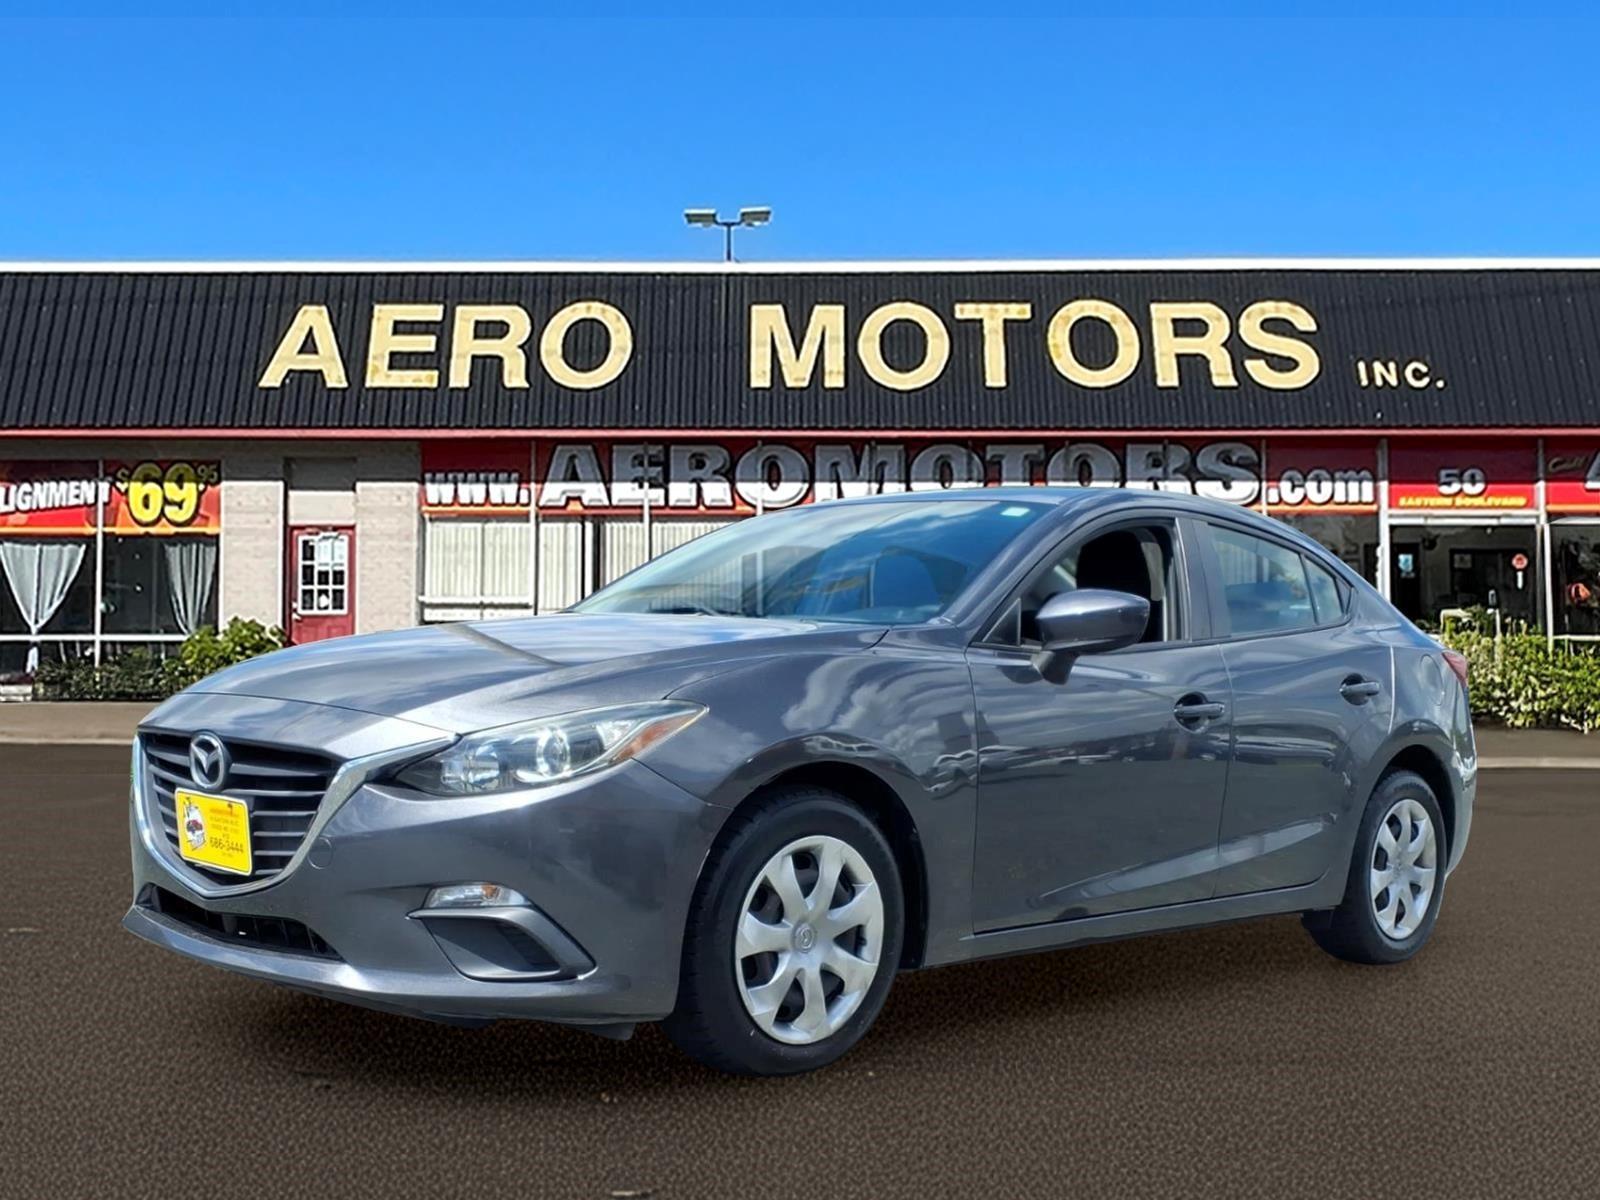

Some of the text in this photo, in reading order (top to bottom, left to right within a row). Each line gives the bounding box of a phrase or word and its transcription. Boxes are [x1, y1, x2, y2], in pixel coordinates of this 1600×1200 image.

[258, 301, 1321, 391] AERO MOTORS
[1356, 358, 1447, 389] INC.
[1438, 468, 1486, 496] 50
